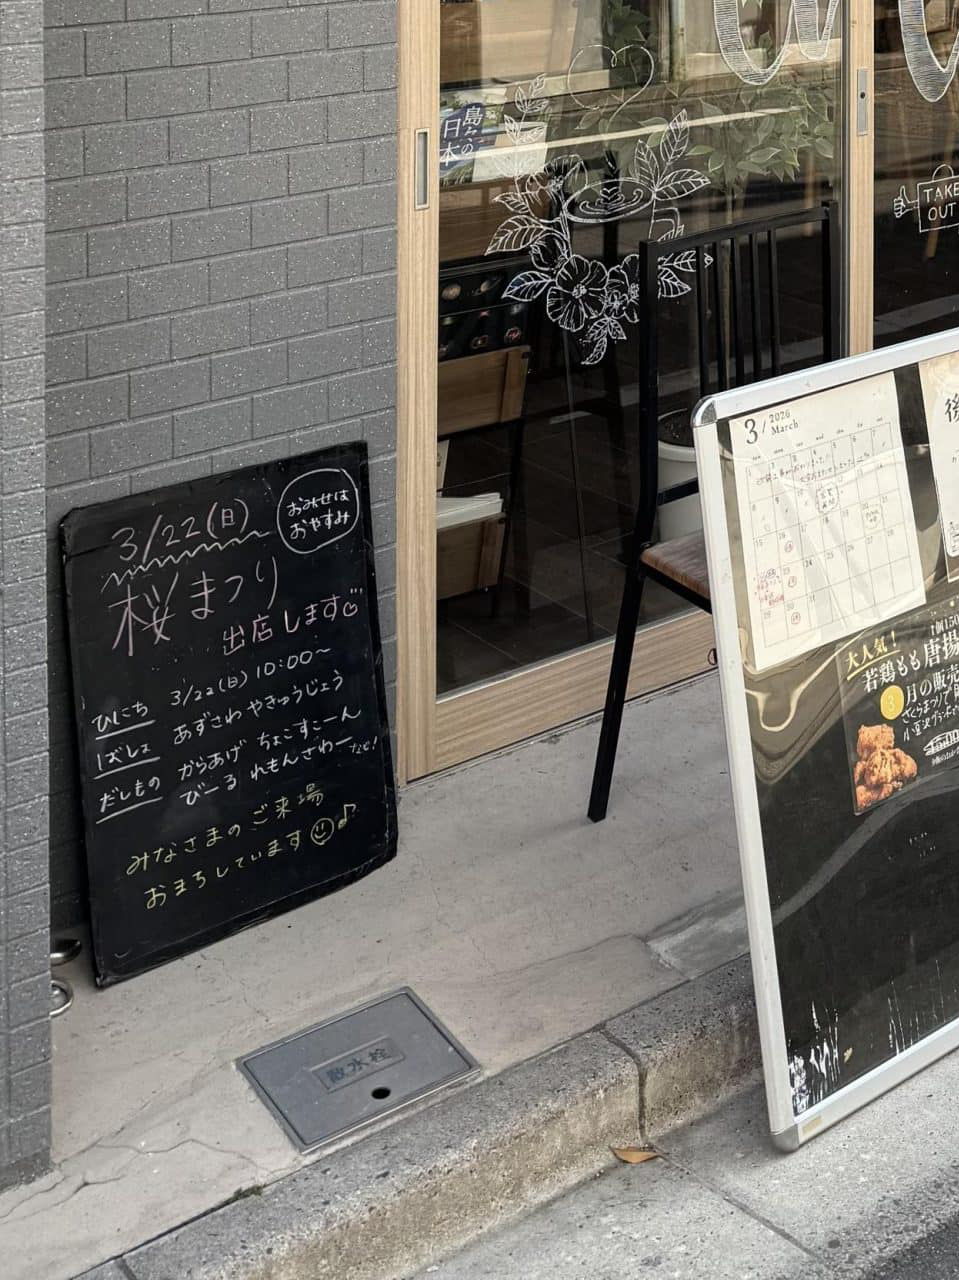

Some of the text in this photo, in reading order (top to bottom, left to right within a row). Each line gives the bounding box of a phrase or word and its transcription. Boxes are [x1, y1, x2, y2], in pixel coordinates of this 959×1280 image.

[928, 202, 957, 221] OUT
[771, 419, 799, 435] March
[286, 489, 351, 517] おみせは
[111, 497, 249, 563] 3/22(日)
[289, 509, 351, 540] おやすみ
[91, 700, 149, 733] ひにち
[100, 775, 161, 813] だしもの
[178, 738, 249, 782] からあげ
[179, 773, 238, 807] びーる
